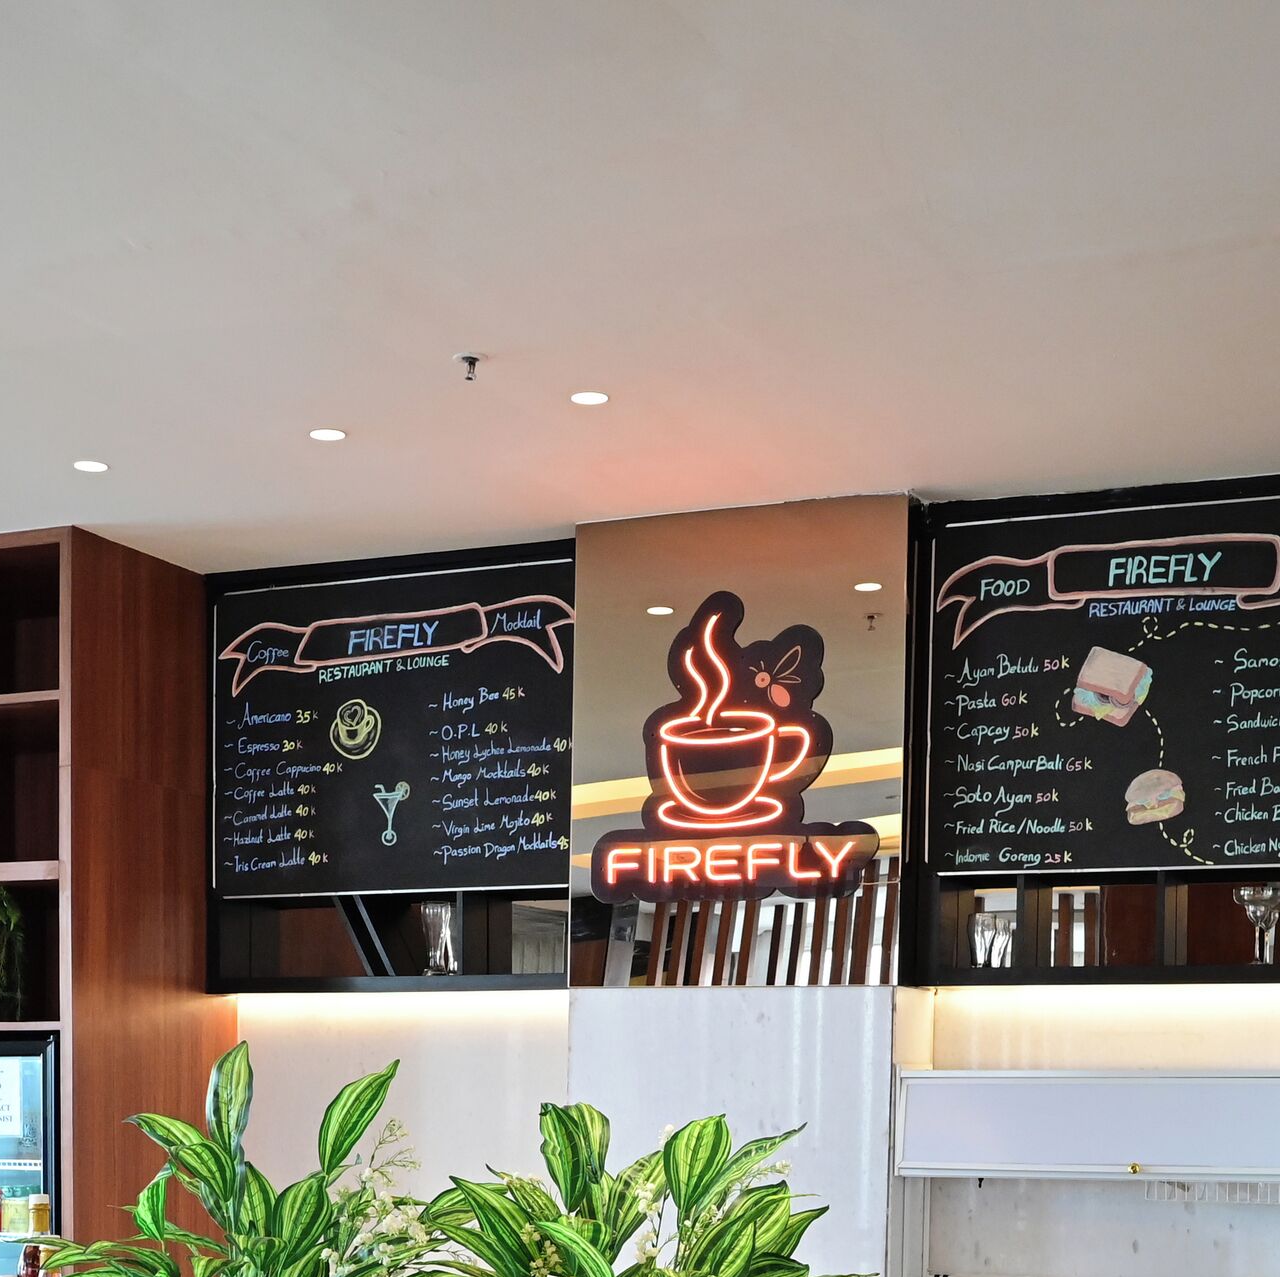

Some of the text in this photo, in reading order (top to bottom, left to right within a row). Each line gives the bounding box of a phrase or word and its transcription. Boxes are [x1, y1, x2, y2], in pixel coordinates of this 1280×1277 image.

[1108, 551, 1222, 587] FIREFLY
[980, 579, 1030, 601] FOOD
[1088, 597, 1236, 618] RESTAURANT & LOUNGE
[348, 621, 439, 655] FIREFLY
[246, 640, 289, 664] Coffee
[318, 655, 450, 684] RESTAURANT & LOUNGE
[957, 656, 995, 689] Ayam
[442, 691, 474, 714] Honey
[478, 687, 500, 705] Bee
[955, 690, 996, 717] Pasta
[237, 702, 292, 729] Americano
[957, 722, 1010, 745] Capcay
[238, 737, 280, 755] Espresso
[442, 745, 470, 765] Honey
[473, 740, 504, 761] Lychee
[507, 736, 551, 753] Lemonade
[1227, 745, 1267, 767] French
[234, 762, 271, 782] Coffee
[442, 769, 472, 789] Mango
[476, 758, 526, 781] Mocktails
[957, 754, 985, 772] Nasi
[1036, 754, 1064, 772] Bali
[233, 787, 265, 804] Coffee
[269, 781, 294, 798] Latte
[442, 788, 479, 811] Sunset
[483, 783, 534, 806] Lemonade
[953, 784, 992, 808] Soto
[993, 785, 1032, 817] Ayam
[1226, 779, 1256, 799] Fried
[233, 804, 267, 825] Caramel
[270, 804, 292, 819] Latte
[1224, 802, 1268, 823] Chicken
[267, 825, 292, 843] Latte
[442, 820, 470, 841] Virgin
[474, 817, 496, 833] Lime
[499, 810, 530, 836] Mojito
[956, 819, 985, 835] Fried
[441, 845, 481, 865] Passion
[484, 842, 516, 860] Dragon
[956, 849, 990, 865] Indomie
[999, 847, 1041, 869] Goreng
[1224, 837, 1266, 856] Chicken
[234, 855, 249, 873] Iris
[606, 841, 857, 884] FIREFLY
